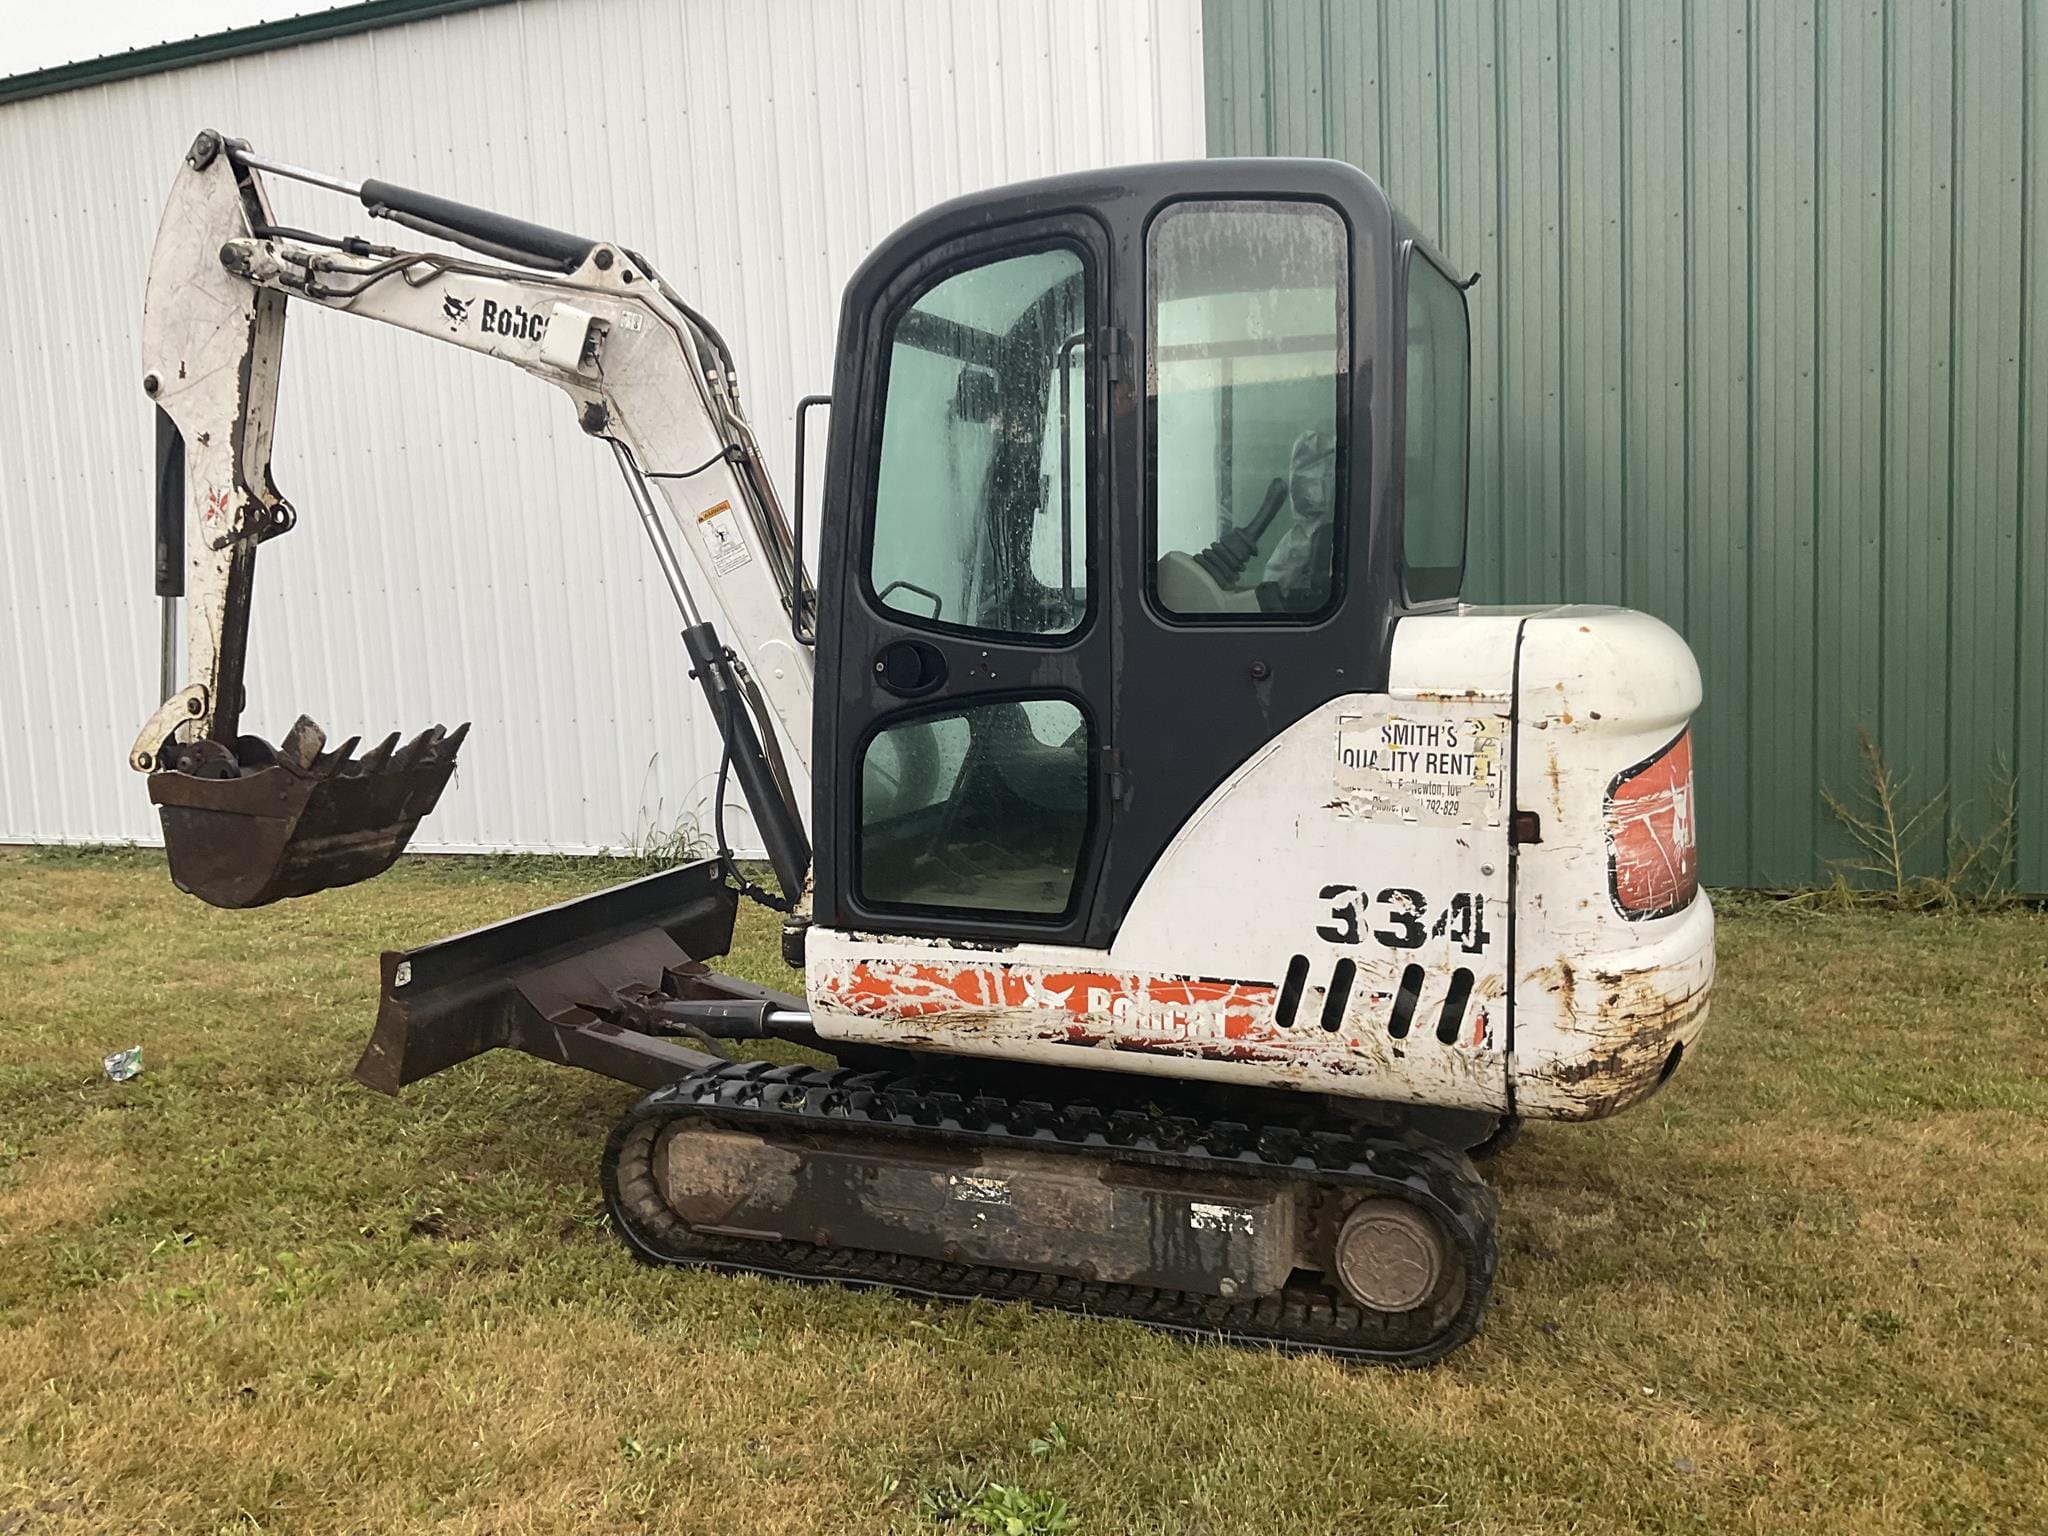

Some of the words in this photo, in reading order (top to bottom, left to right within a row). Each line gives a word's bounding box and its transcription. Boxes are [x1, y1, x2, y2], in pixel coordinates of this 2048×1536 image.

[481, 299, 550, 342] Bobc
[1381, 724, 1458, 748] SMITH'S
[1426, 799, 1460, 816] 792-829
[1316, 884, 1490, 954] 334
